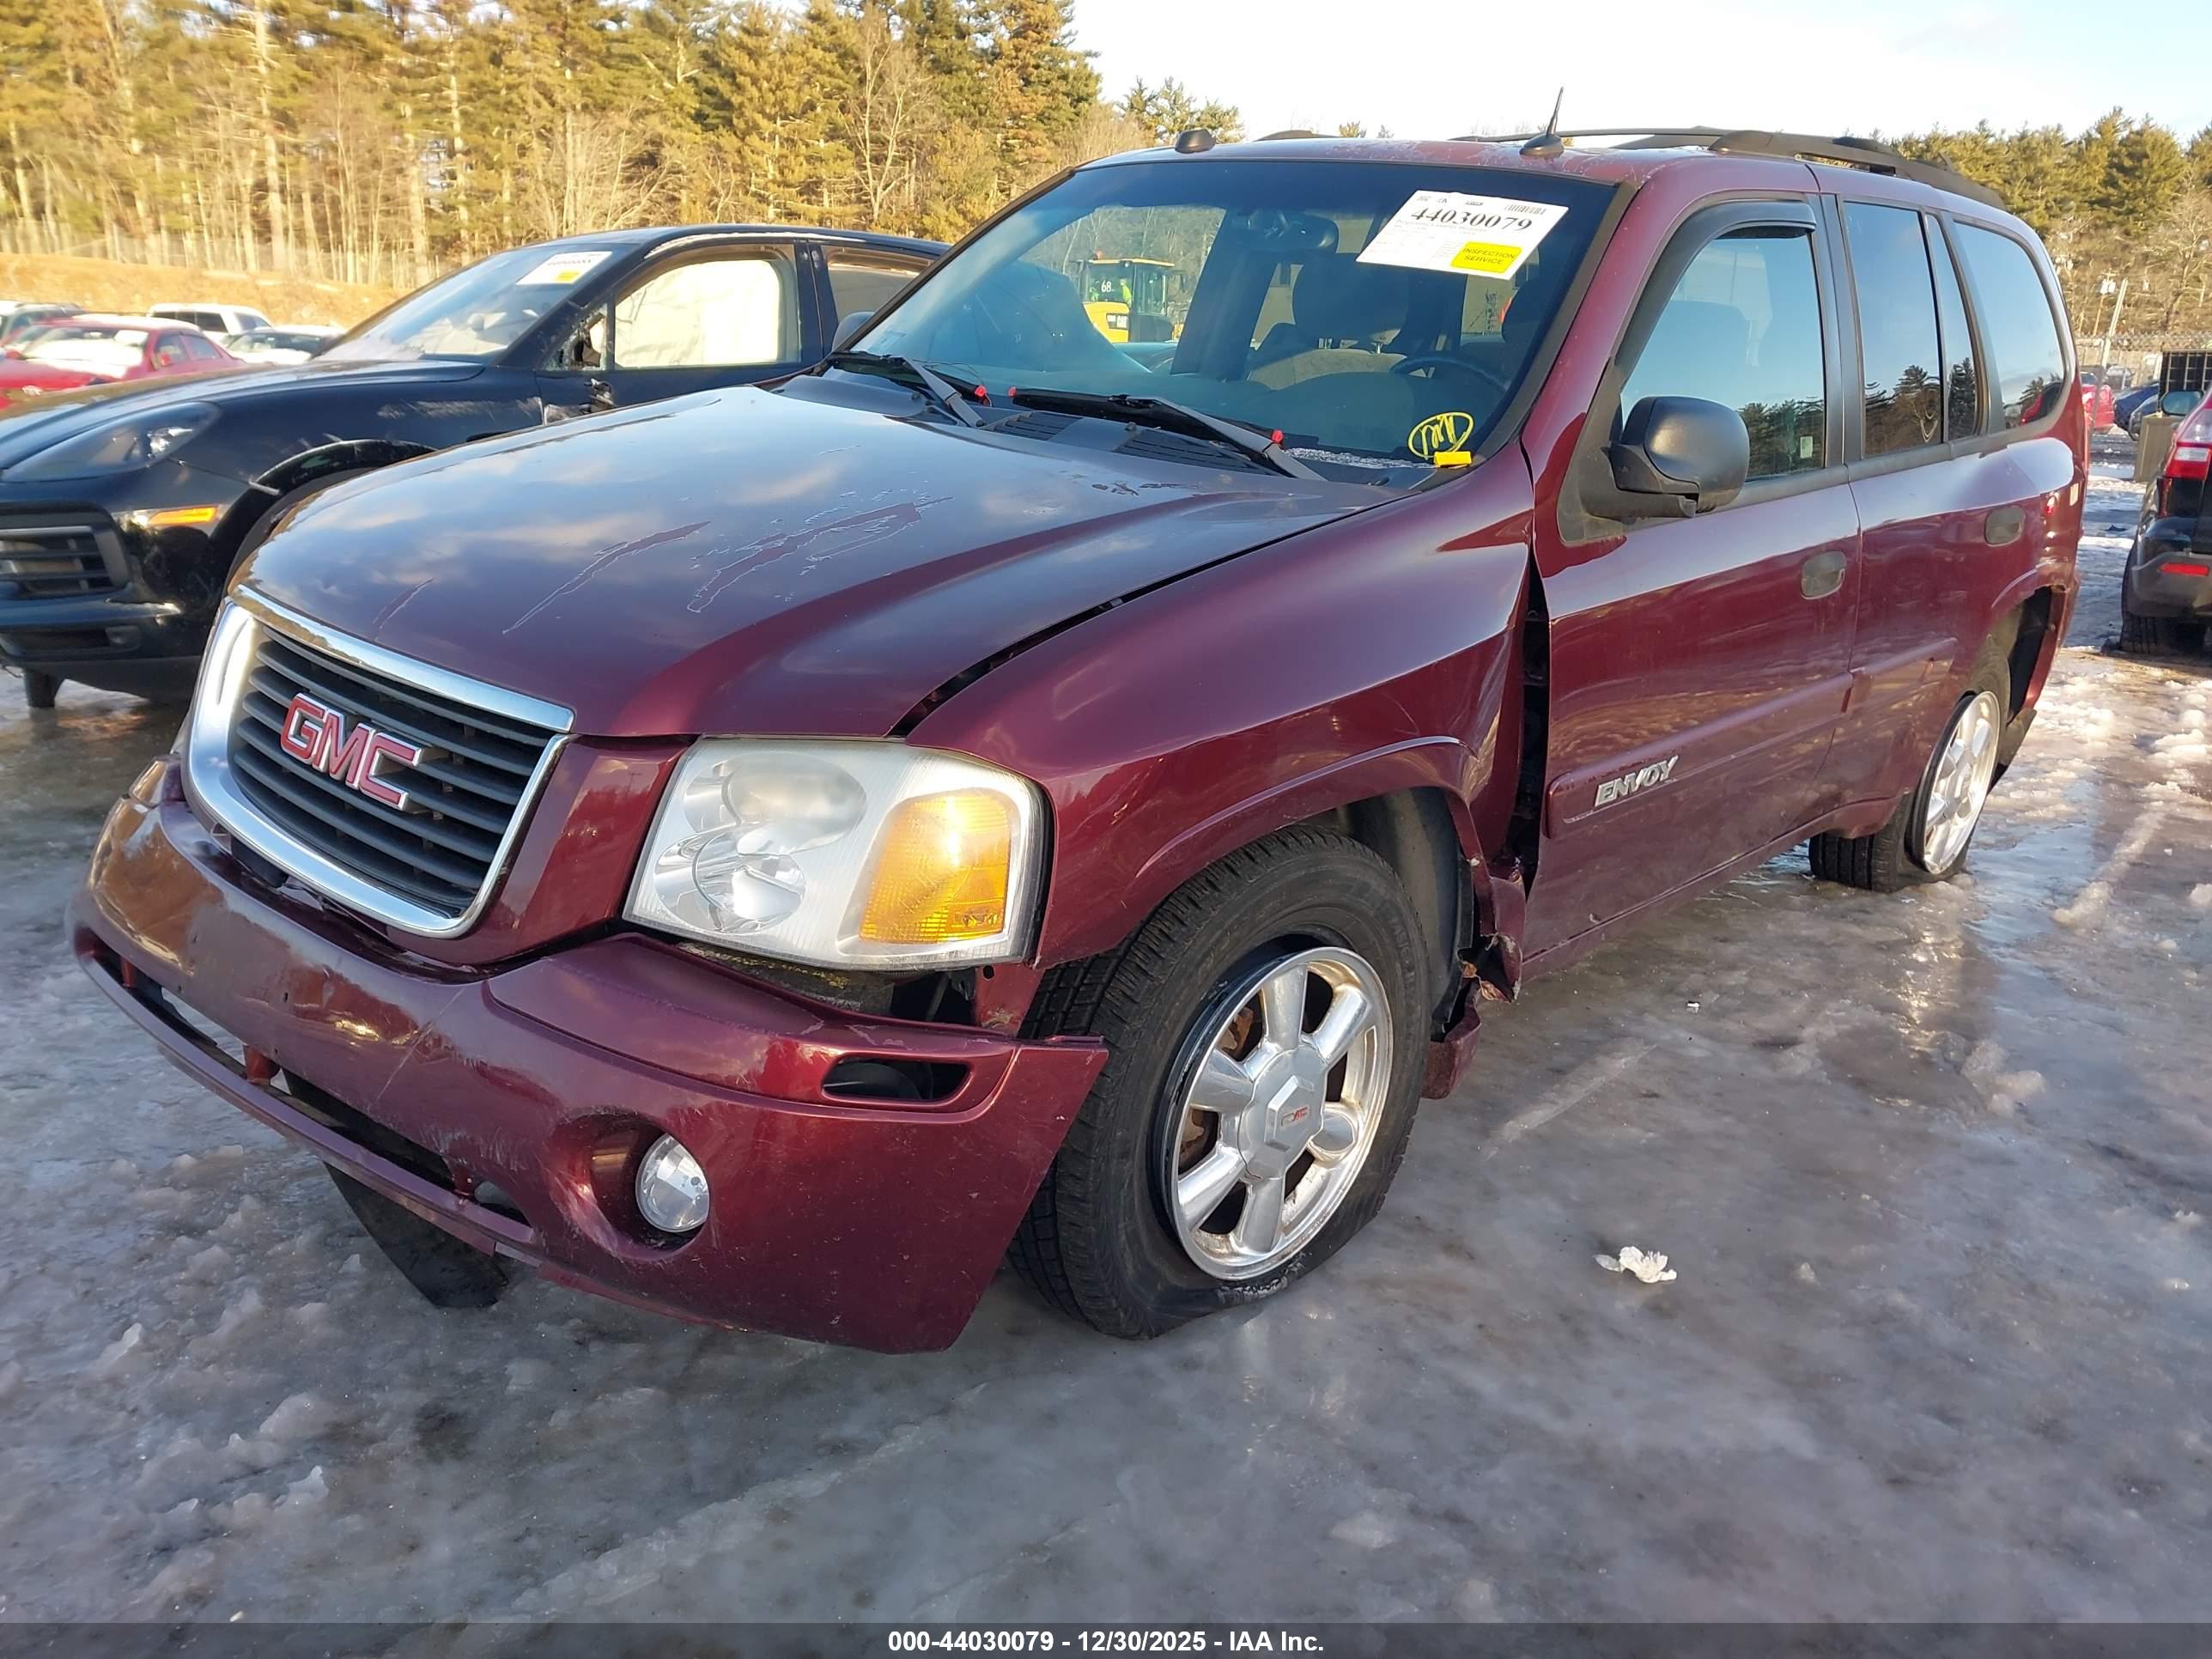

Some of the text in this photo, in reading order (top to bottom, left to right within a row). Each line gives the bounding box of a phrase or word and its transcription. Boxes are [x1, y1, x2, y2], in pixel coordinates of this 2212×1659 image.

[1411, 206, 1533, 231] 44030079
[1462, 247, 1516, 258] INSPECTION
[1101, 280, 1112, 293] 68
[281, 692, 423, 811] GMC
[1595, 755, 1679, 807] ENVOY
